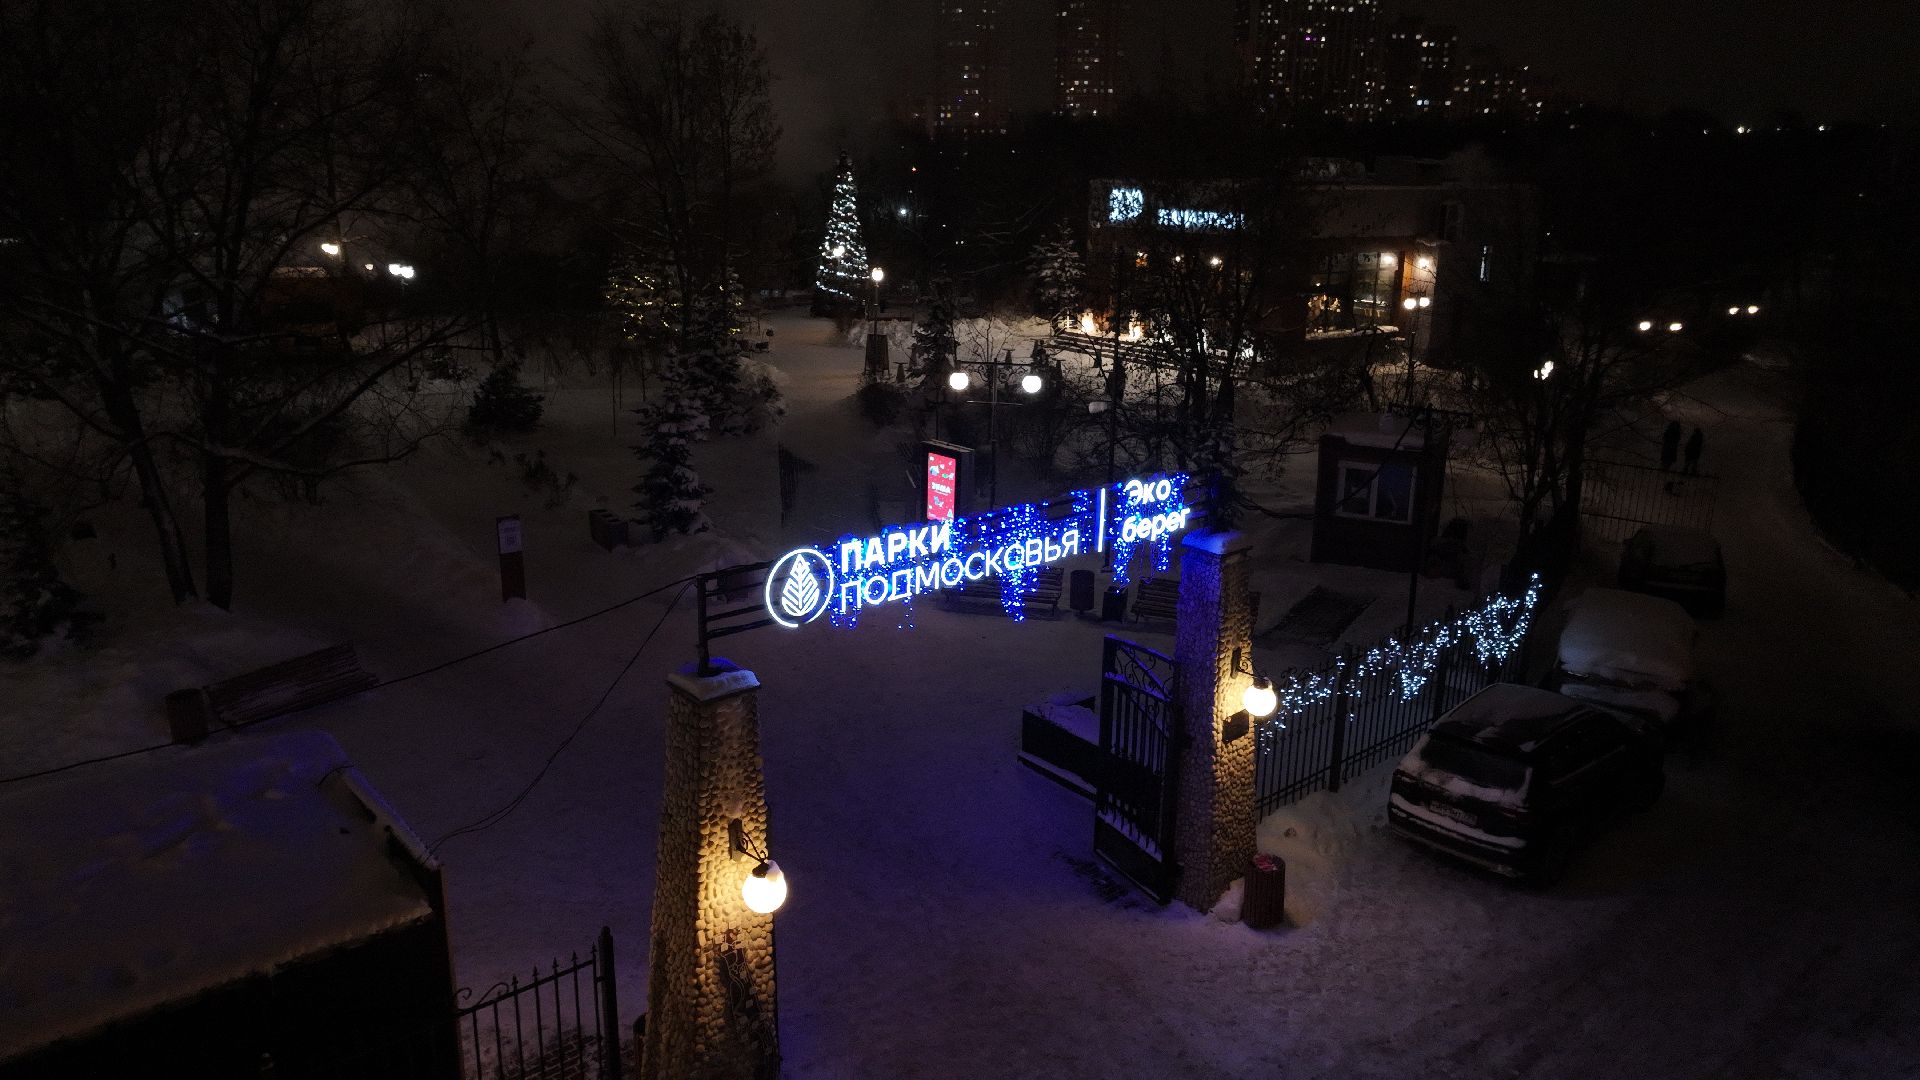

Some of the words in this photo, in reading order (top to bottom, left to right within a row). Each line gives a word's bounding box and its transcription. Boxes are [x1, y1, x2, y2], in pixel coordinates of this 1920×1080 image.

[1124, 479, 1172, 506] Эко
[840, 521, 952, 574] ПАРКИ
[1121, 508, 1191, 544] берег
[839, 530, 1079, 613] ПОДМОСКОВЬЯ
